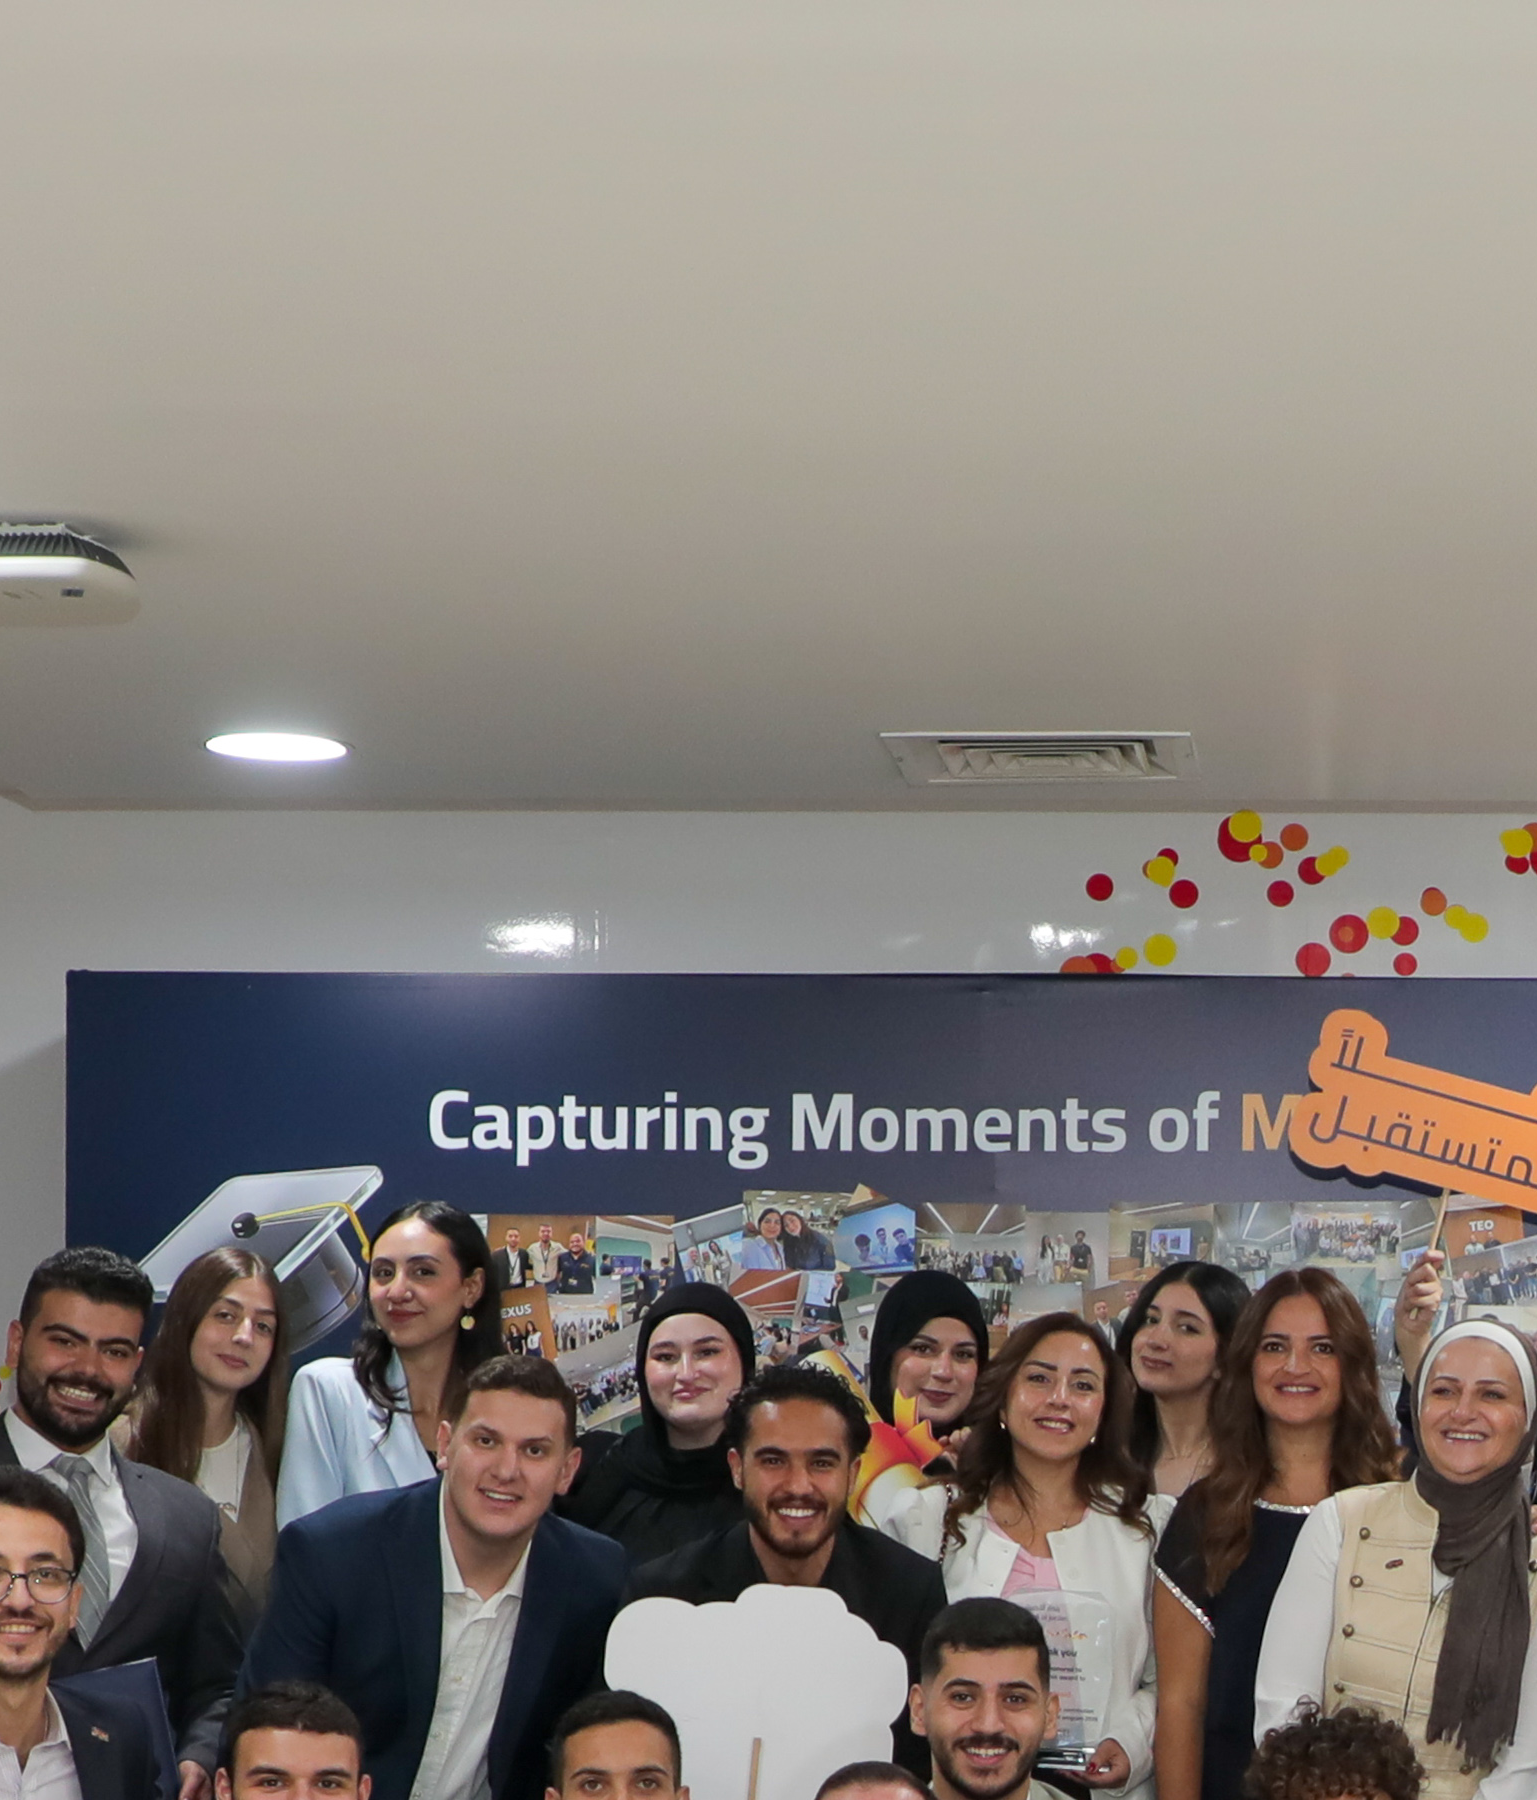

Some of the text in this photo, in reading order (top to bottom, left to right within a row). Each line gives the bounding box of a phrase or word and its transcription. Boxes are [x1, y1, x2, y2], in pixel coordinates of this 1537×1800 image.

[428, 1090, 1304, 1170] Capturing Moments of M
[1468, 1220, 1494, 1232] TEO
[500, 1303, 532, 1319] EXUS
